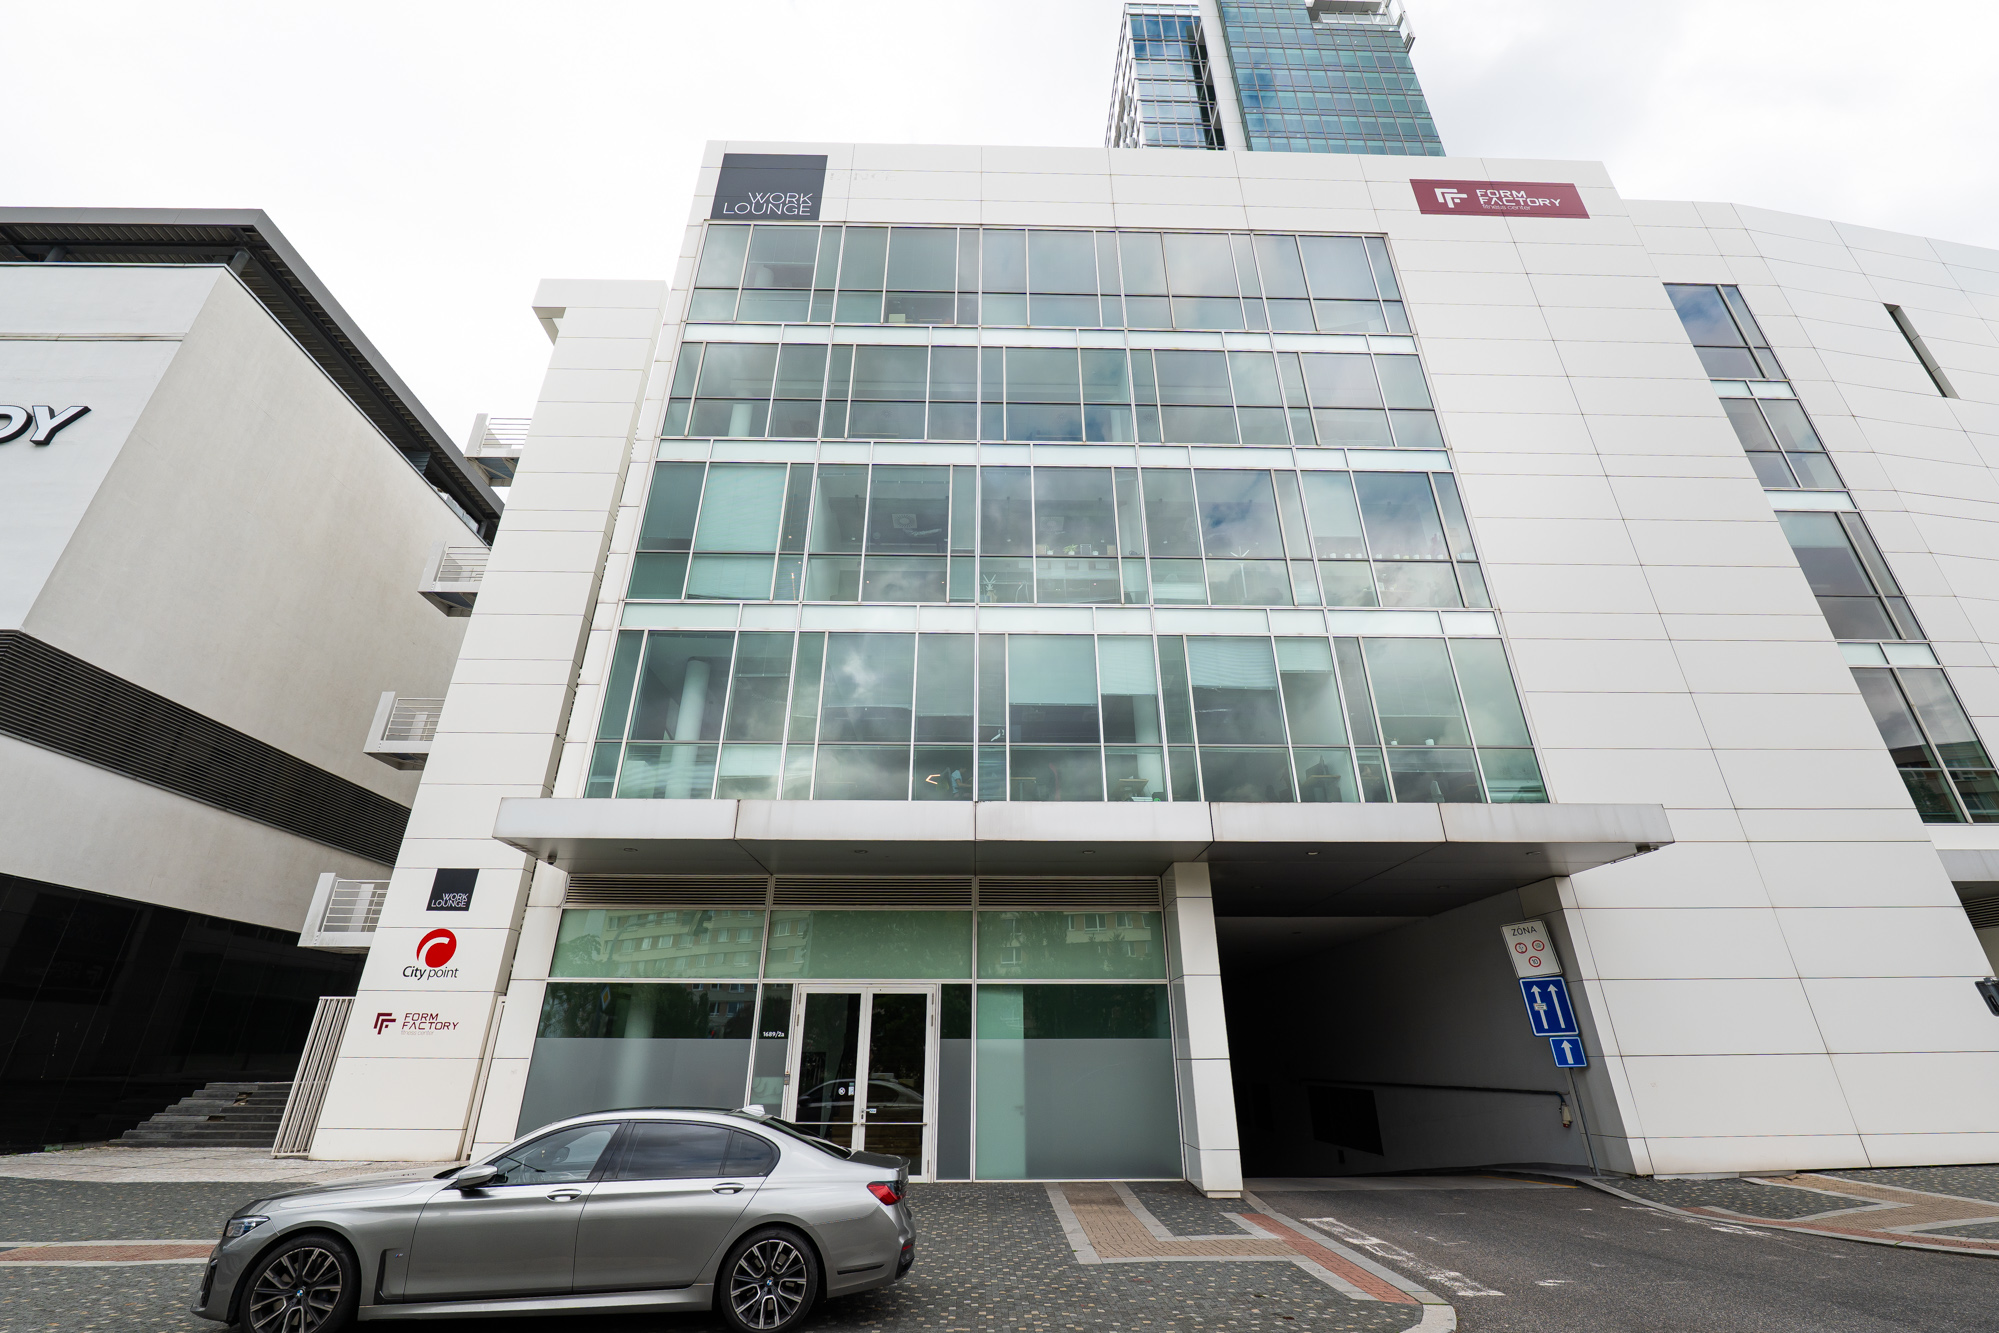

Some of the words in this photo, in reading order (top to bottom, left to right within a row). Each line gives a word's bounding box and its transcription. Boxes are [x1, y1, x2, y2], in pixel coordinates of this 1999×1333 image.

[1476, 189, 1527, 198] FORM
[748, 192, 813, 205] WORK
[1479, 197, 1560, 206] FACTORY
[723, 202, 812, 215] LOUNGE
[442, 893, 469, 901] WORK
[431, 899, 467, 908] LOUNGE
[1511, 925, 1537, 936] ZÓNA
[402, 965, 427, 981] City
[426, 966, 459, 981] point
[404, 1012, 439, 1021] FORM
[401, 1021, 459, 1030] FACTORY
